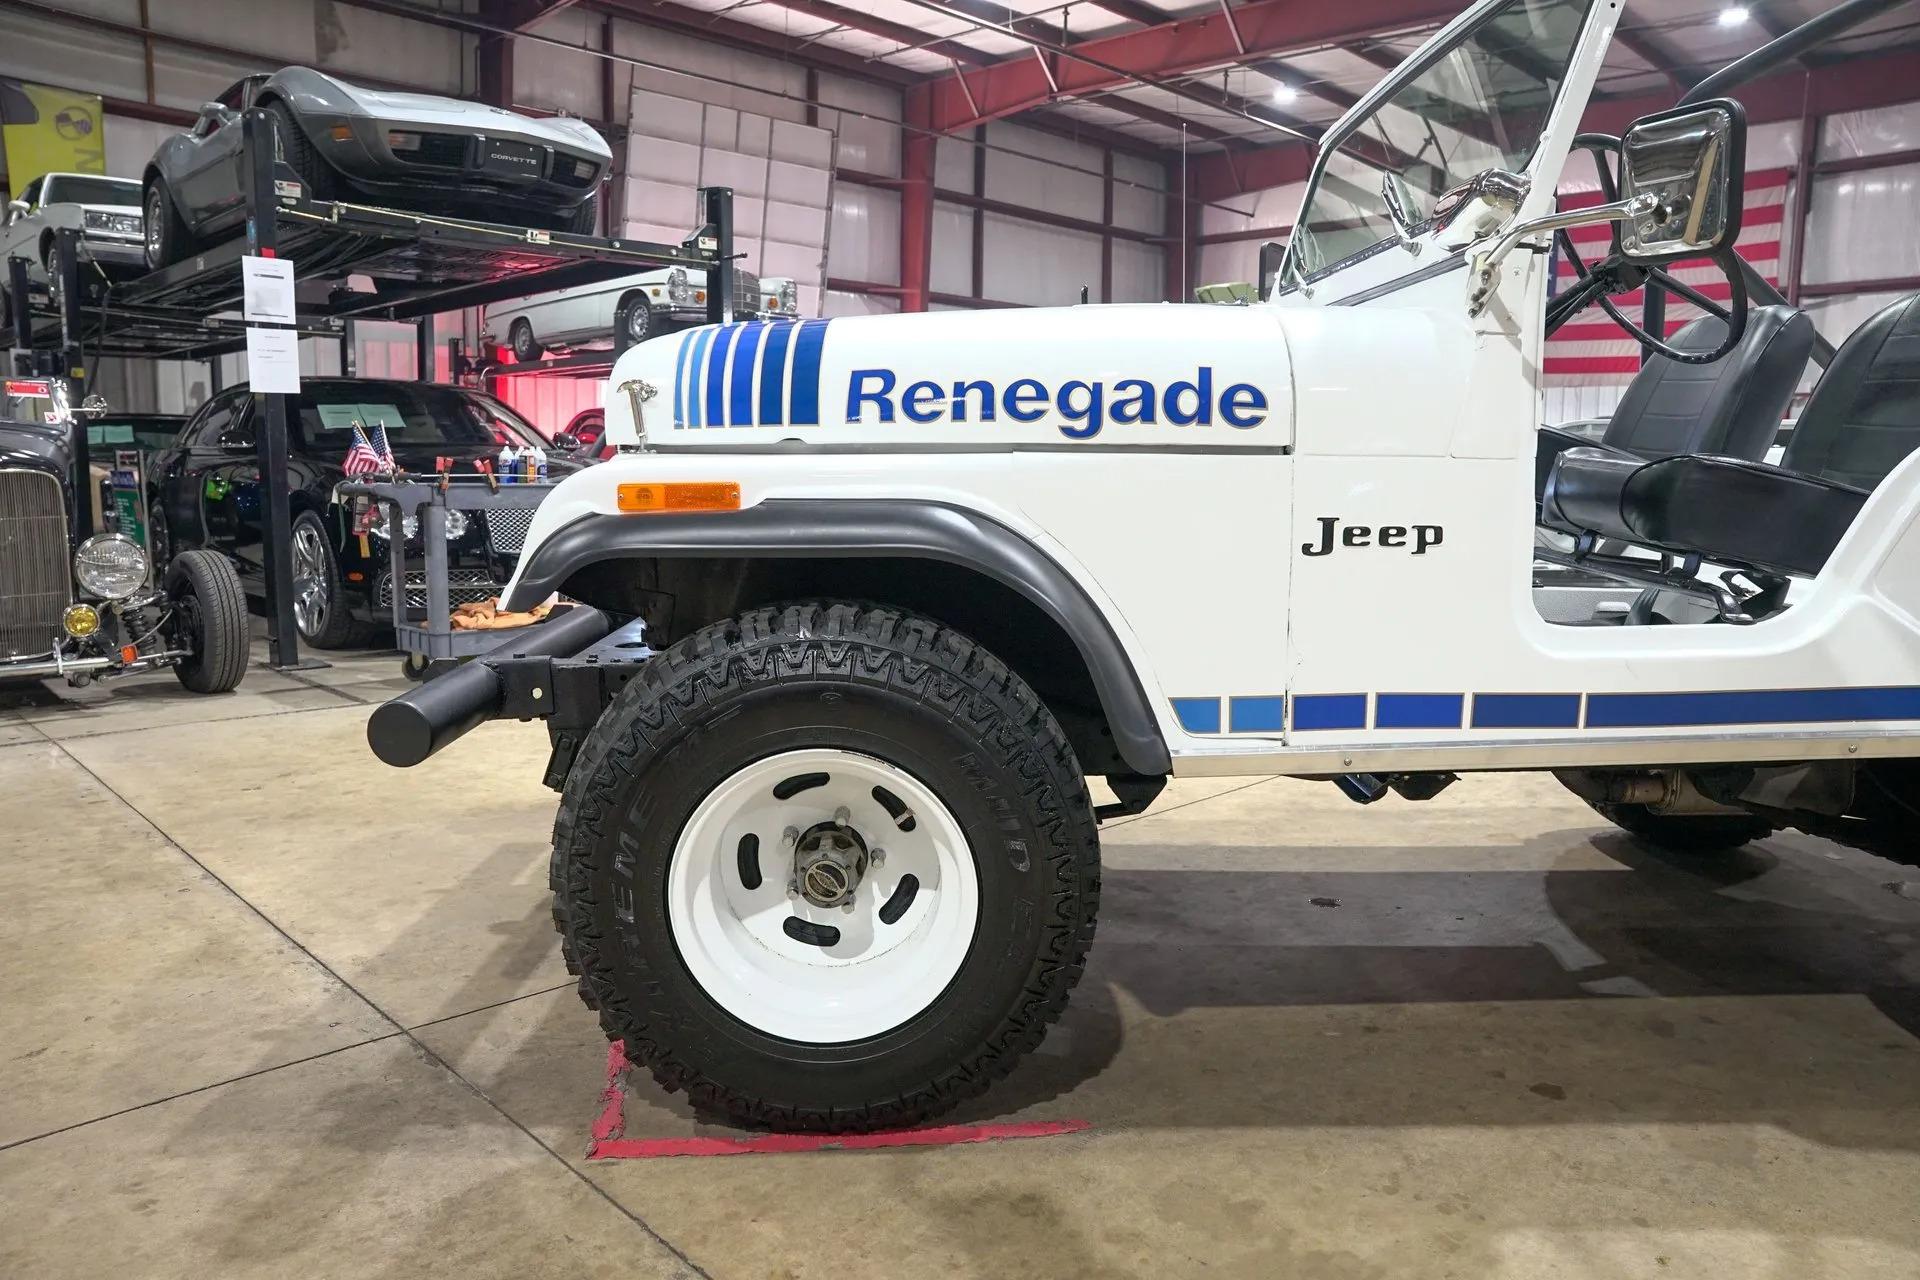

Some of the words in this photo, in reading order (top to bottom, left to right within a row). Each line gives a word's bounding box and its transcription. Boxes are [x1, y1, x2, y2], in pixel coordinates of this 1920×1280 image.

[491, 153, 537, 165] CORVETTE
[845, 366, 1269, 440] Renegade
[1301, 517, 1444, 556] Jeep
